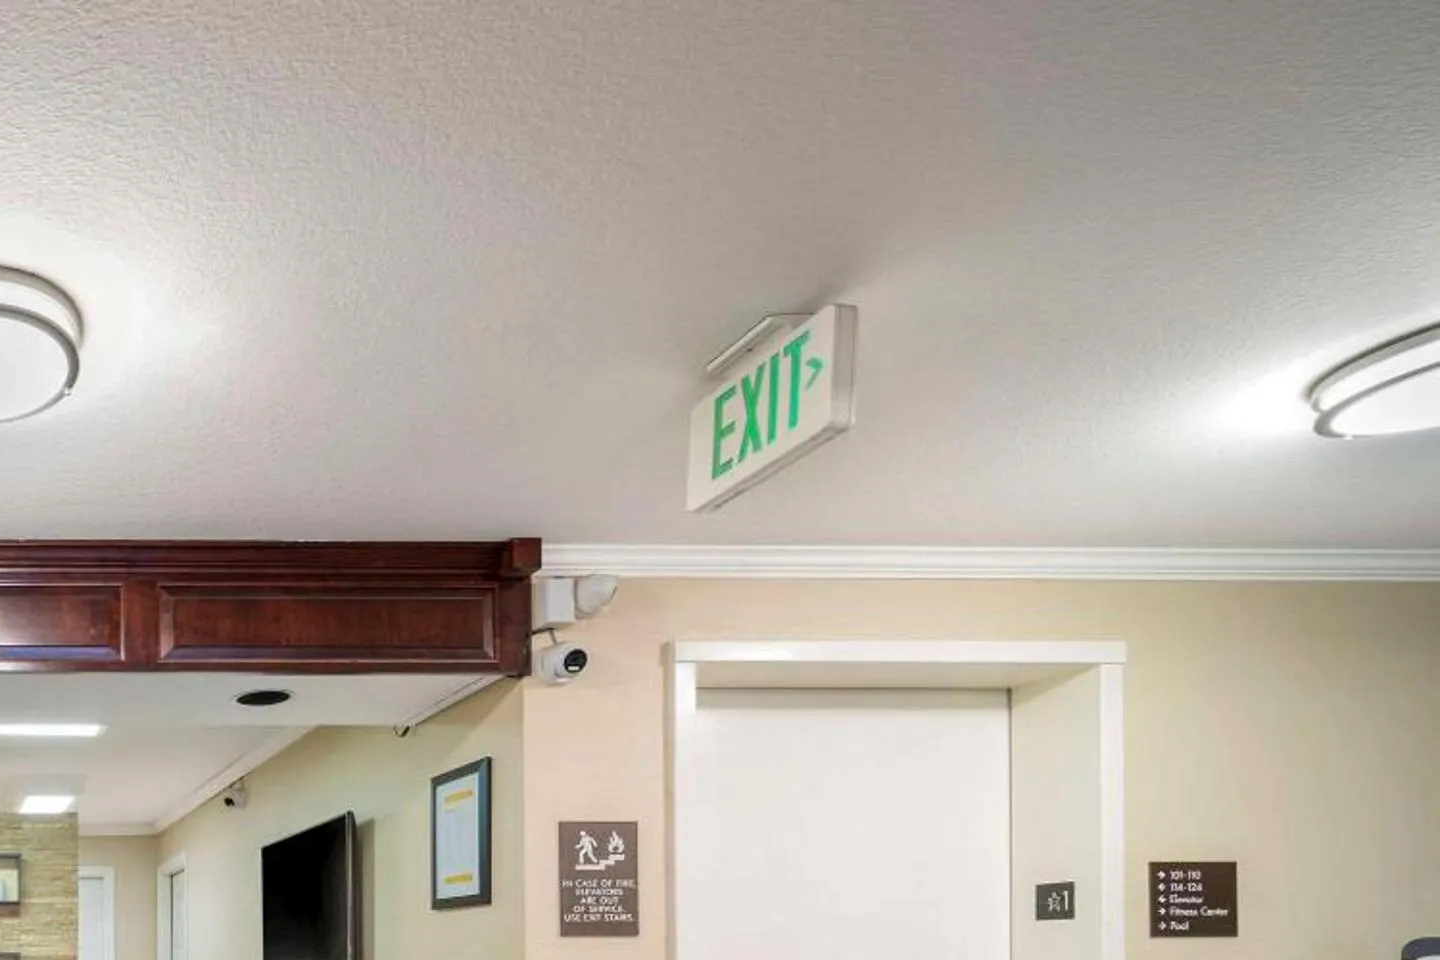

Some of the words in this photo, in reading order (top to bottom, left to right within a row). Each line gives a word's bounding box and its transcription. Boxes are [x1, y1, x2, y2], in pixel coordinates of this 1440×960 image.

[711, 329, 811, 480] EXIT
[576, 879, 598, 888] CASE
[1200, 906, 1229, 916] Center
